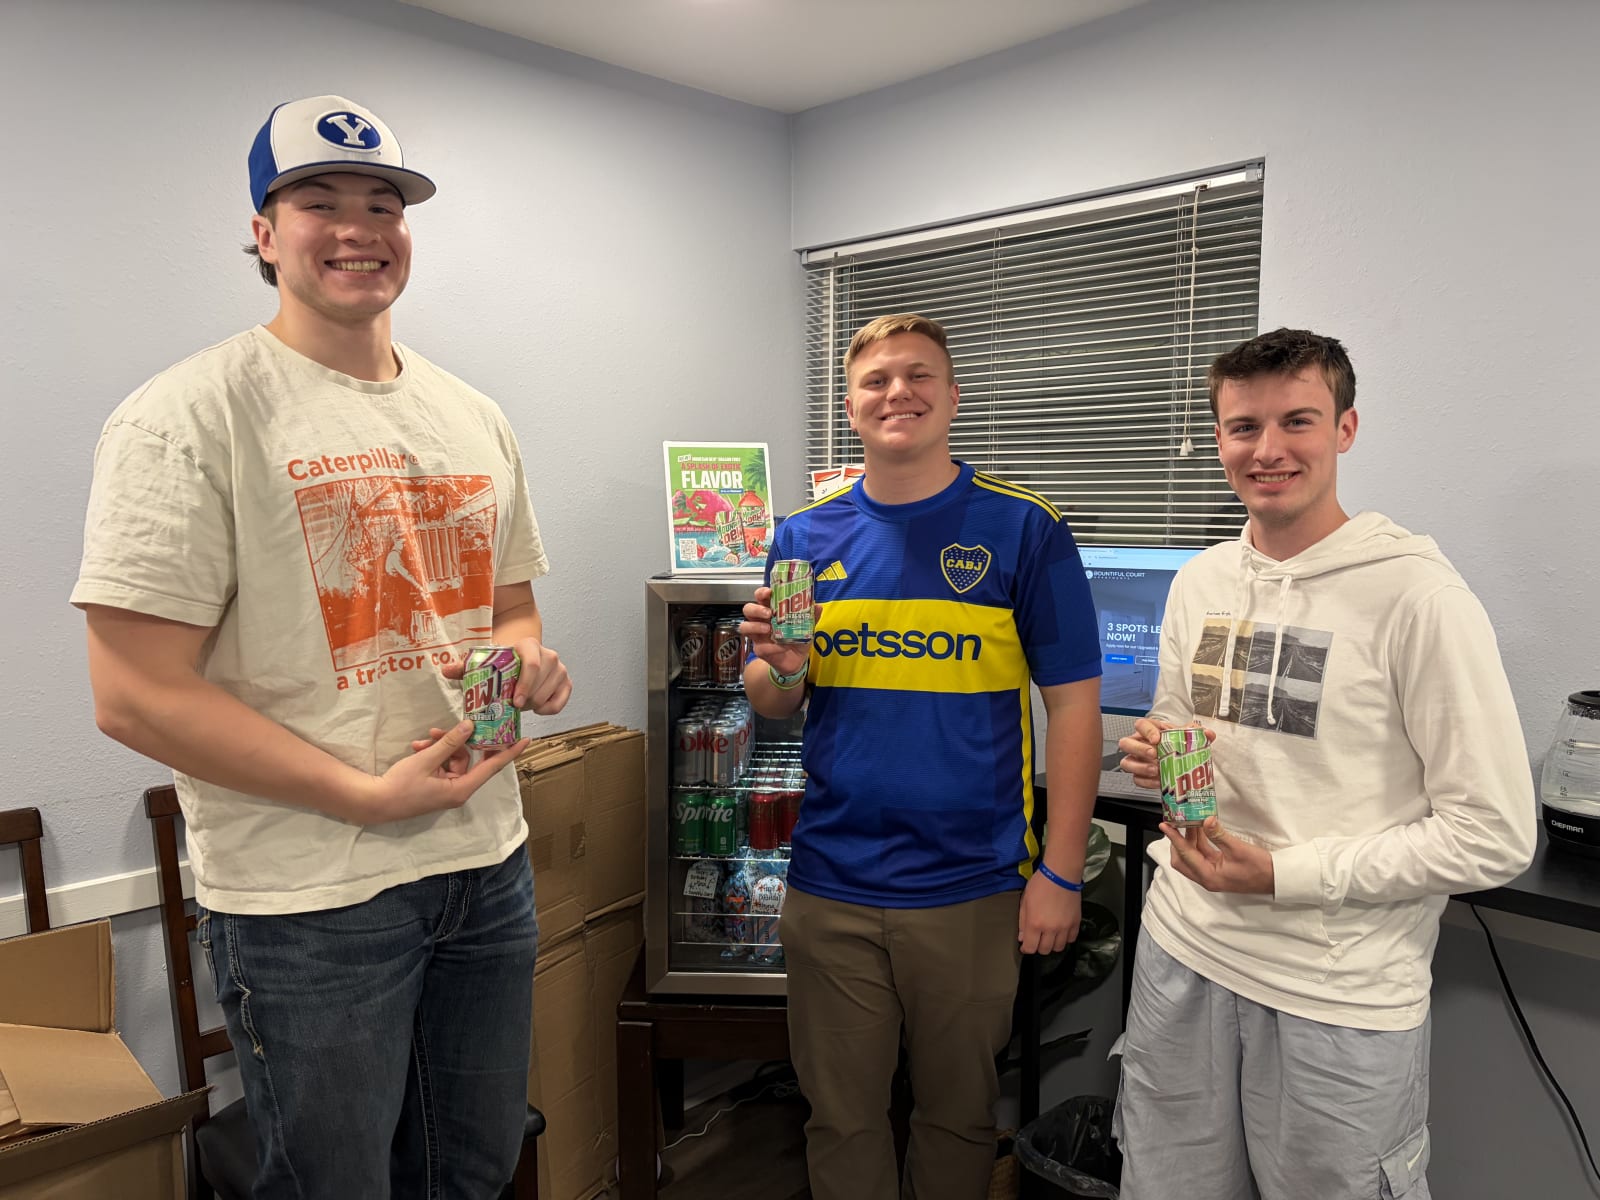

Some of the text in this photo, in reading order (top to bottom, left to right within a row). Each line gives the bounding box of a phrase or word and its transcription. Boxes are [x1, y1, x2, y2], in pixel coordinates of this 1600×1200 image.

[326, 115, 371, 146] Y
[681, 470, 744, 489] FLAVOR
[946, 558, 983, 571] CABJ
[1107, 622, 1114, 631] 3
[1116, 623, 1148, 633] SPOTS
[1106, 632, 1136, 642] NOW!
[336, 676, 349, 691] a
[356, 655, 425, 686] trctor
